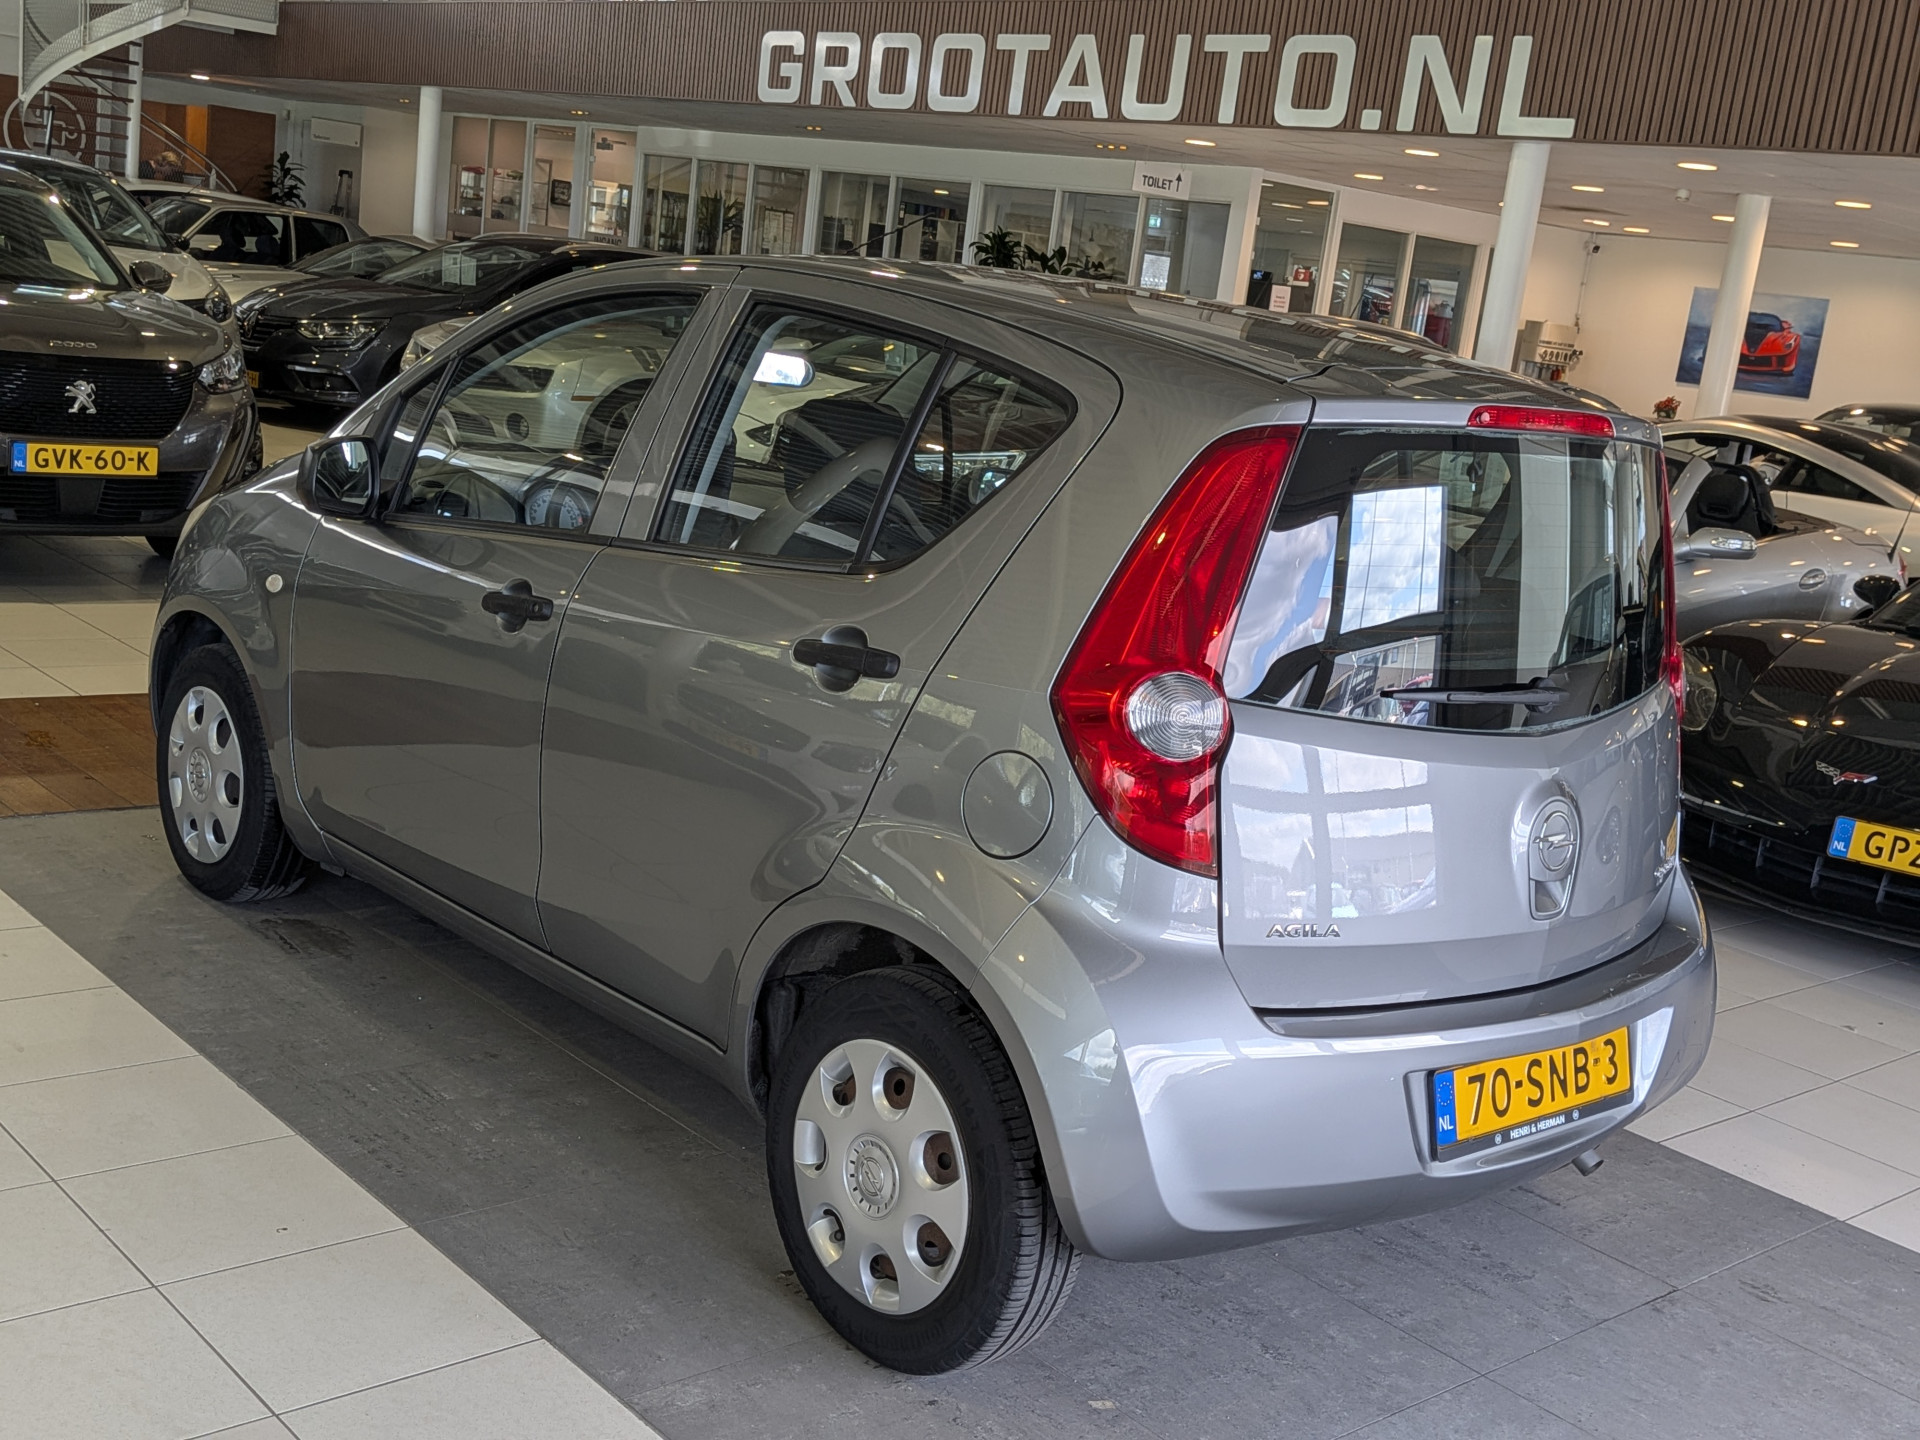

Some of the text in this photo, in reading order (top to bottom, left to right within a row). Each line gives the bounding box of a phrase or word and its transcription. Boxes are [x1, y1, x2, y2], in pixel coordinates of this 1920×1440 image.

[757, 30, 1576, 138] GROOTAUTO.NL
[1142, 174, 1173, 191] TOILET
[14, 460, 25, 468] NL
[34, 447, 151, 472] GVK-60-K
[1832, 840, 1847, 851] NL
[1265, 923, 1341, 938] AGILA
[1466, 1038, 1618, 1125] 70-SNB-3
[1438, 1114, 1454, 1132] NL
[1510, 1114, 1566, 1139] HENRI & HERMAN
